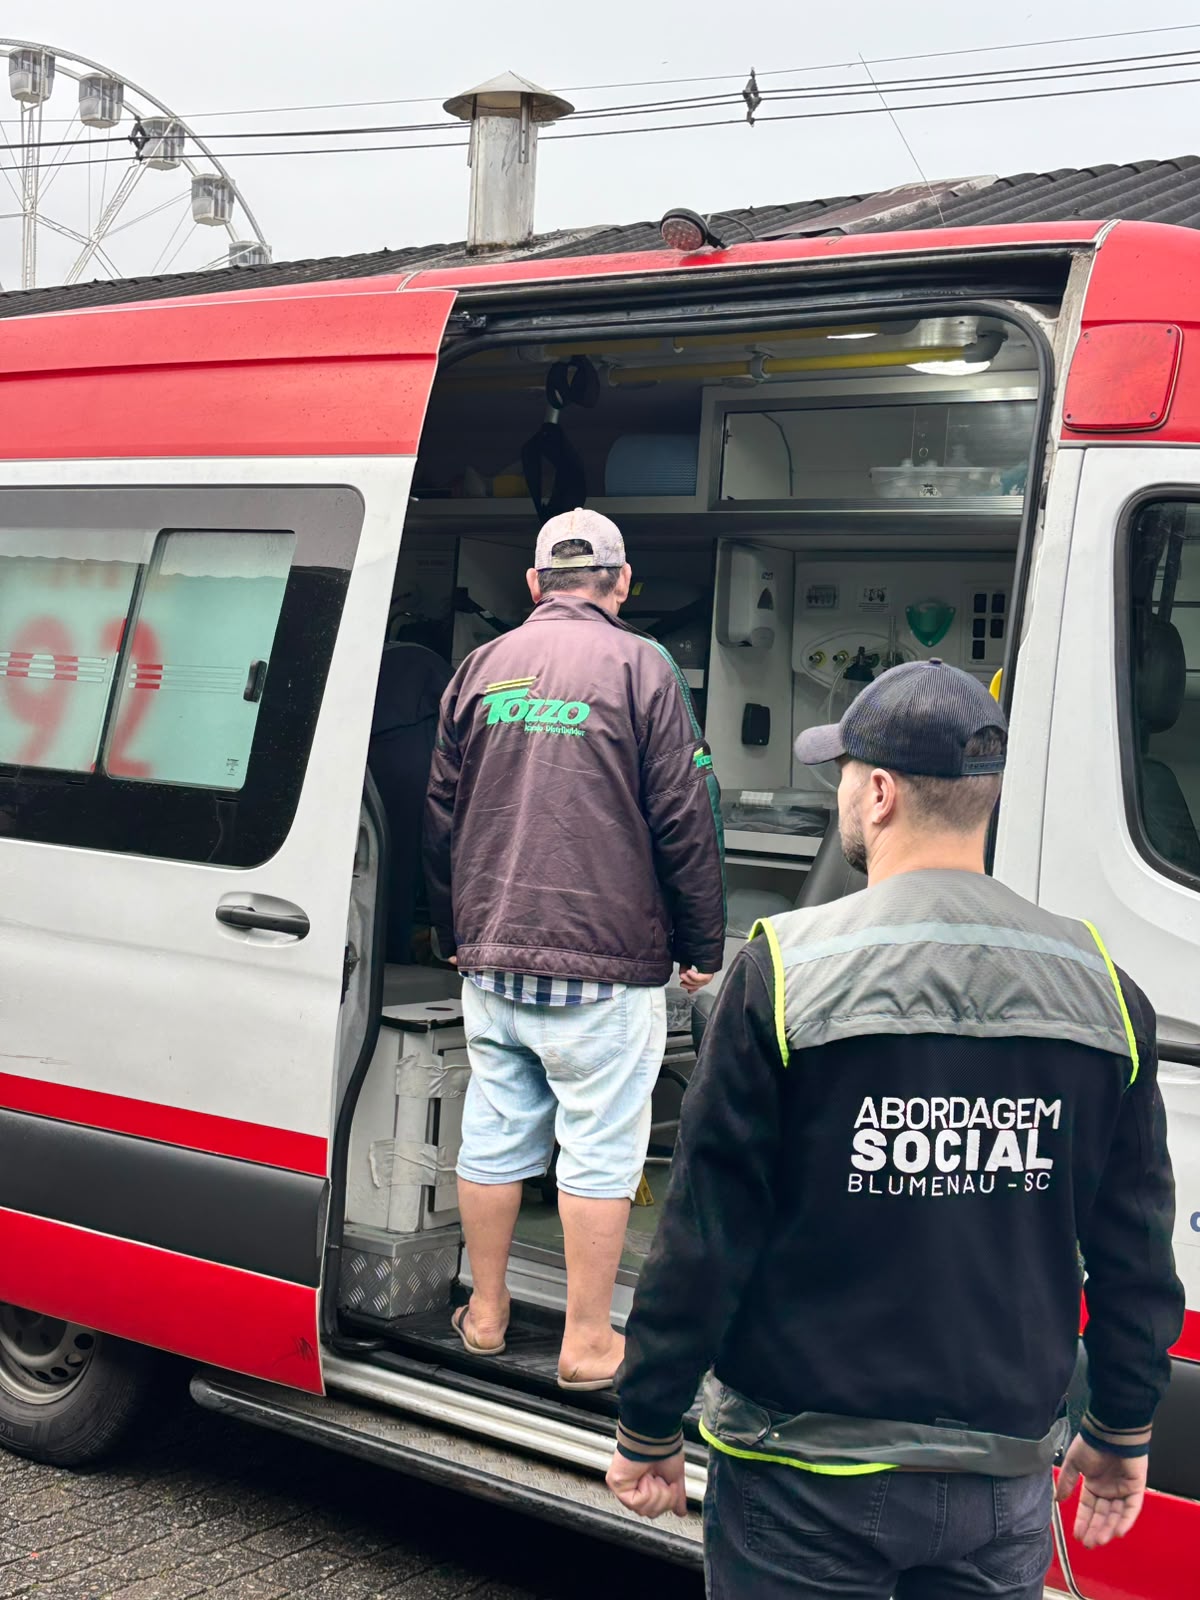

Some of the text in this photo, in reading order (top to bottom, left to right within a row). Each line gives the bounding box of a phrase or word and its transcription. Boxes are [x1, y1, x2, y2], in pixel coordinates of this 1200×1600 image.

[854, 1096, 1062, 1130] ABORDAGEM
[851, 1128, 1054, 1174] SOCIAL
[848, 1173, 995, 1197] BLUMENAU
